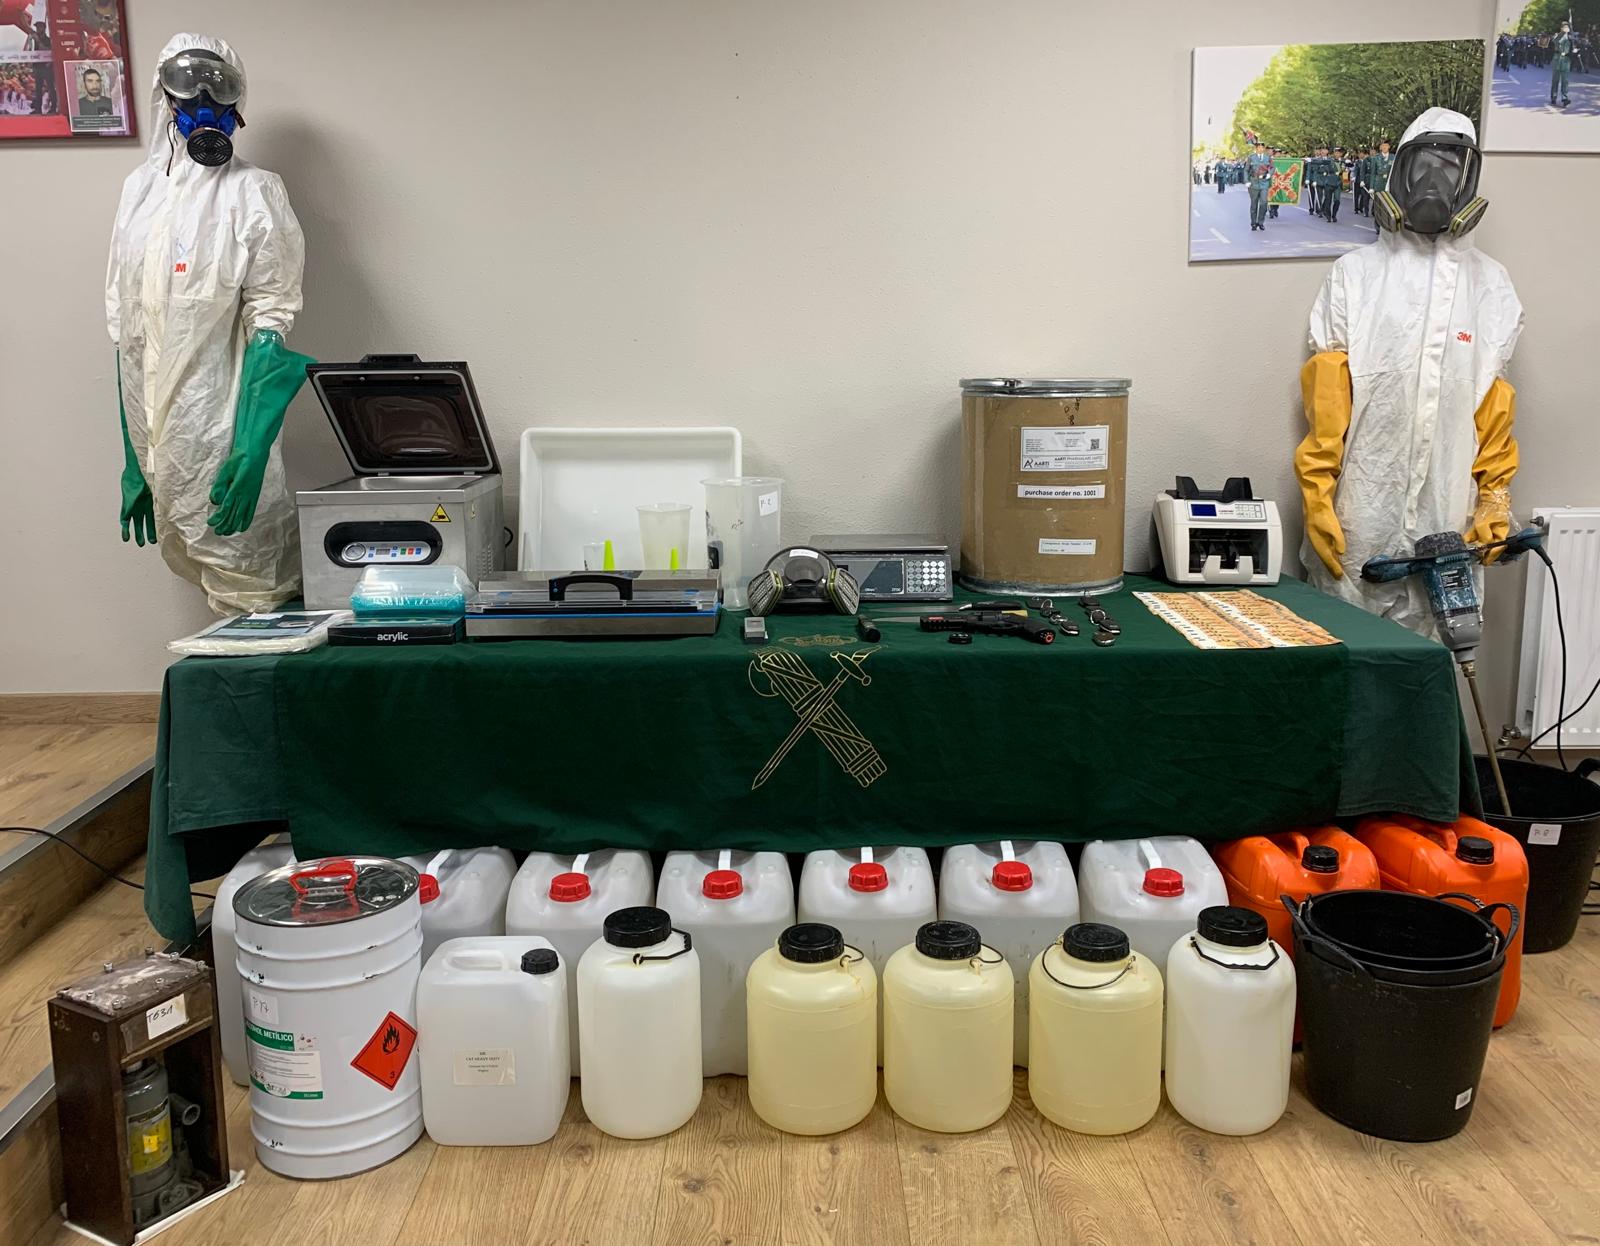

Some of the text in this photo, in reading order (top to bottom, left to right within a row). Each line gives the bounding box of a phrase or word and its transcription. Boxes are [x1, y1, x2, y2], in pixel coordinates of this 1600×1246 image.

[1457, 331, 1472, 343] 3M
[1024, 489, 1053, 497] purchase
[1054, 489, 1071, 497] order
[1084, 489, 1096, 497] 1001
[377, 632, 409, 642] acrylic
[263, 1030, 293, 1042] METÍLICO
[389, 1070, 396, 1079] 3
